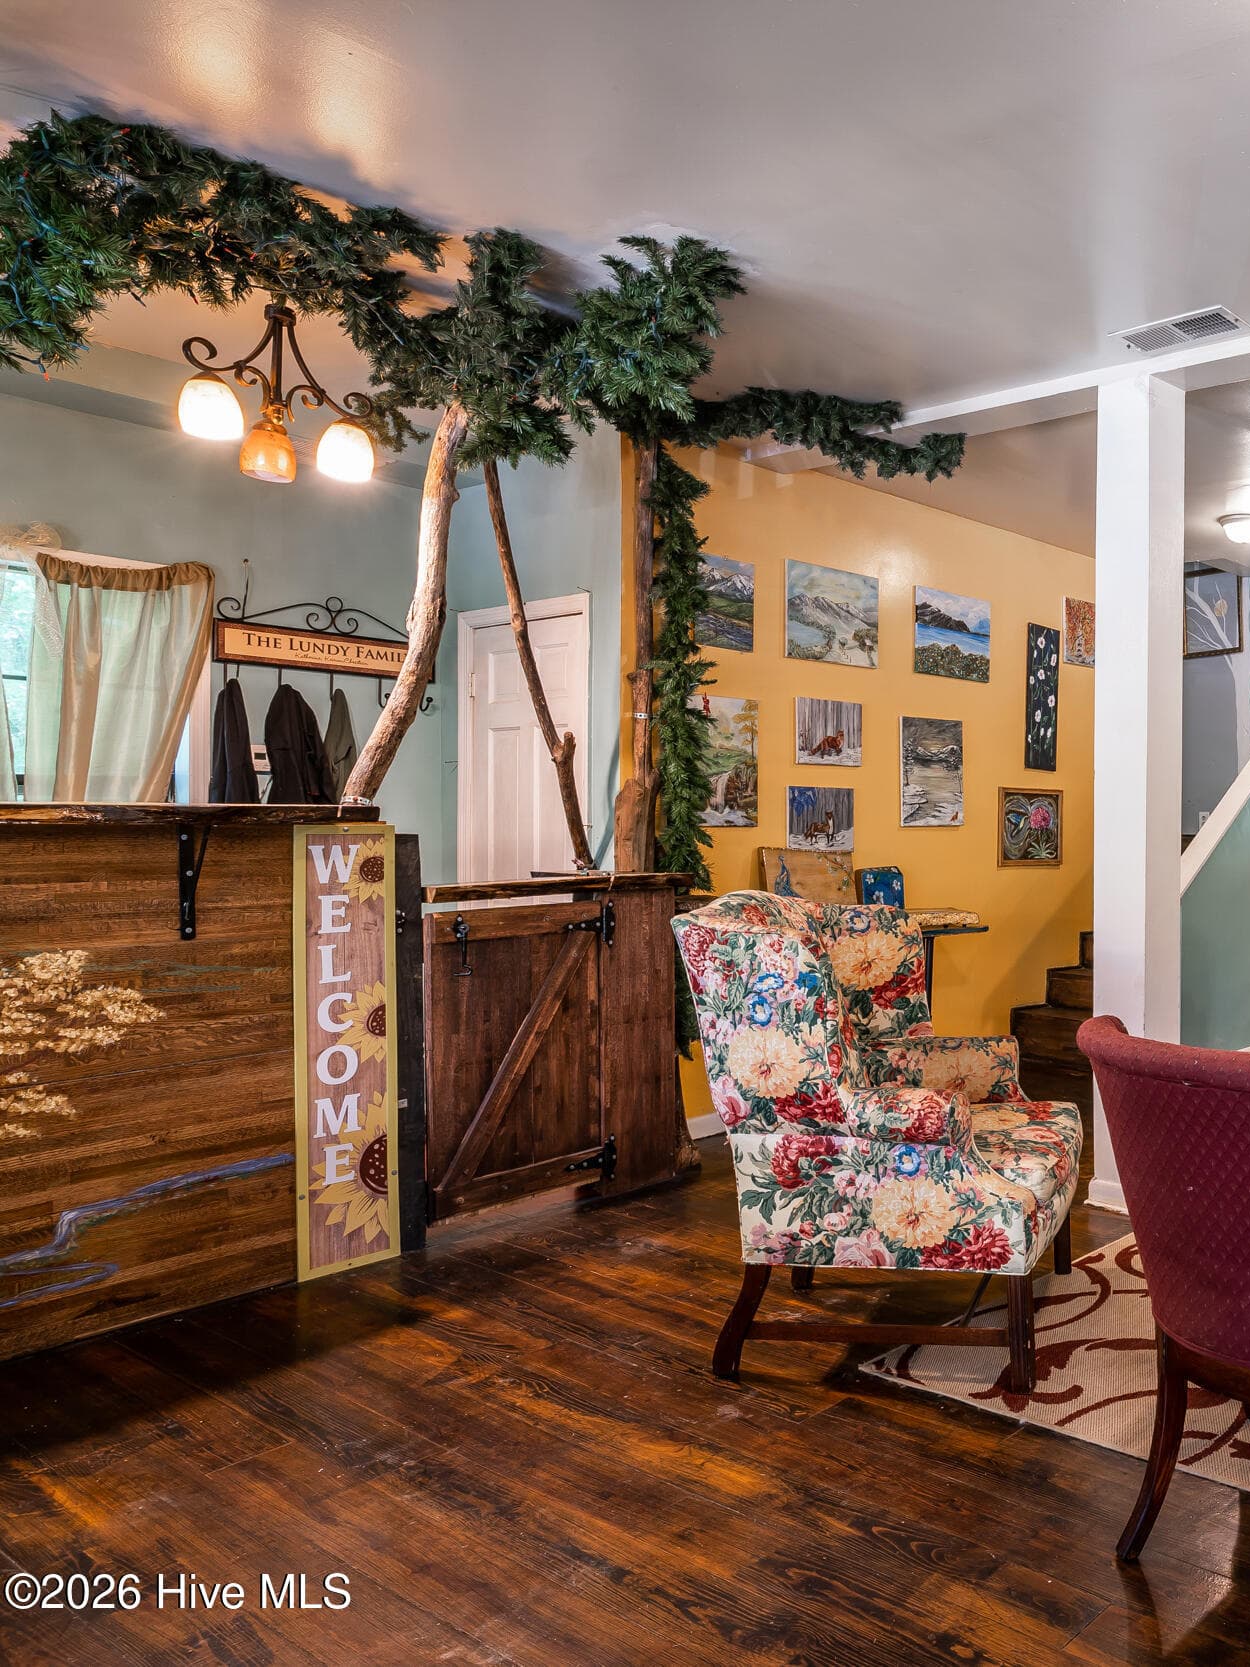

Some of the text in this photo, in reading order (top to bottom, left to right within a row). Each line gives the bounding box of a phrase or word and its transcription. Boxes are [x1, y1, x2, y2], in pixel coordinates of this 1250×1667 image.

[242, 631, 282, 649] THE
[288, 637, 350, 656] LUNDY
[355, 645, 407, 663] FAMIL
[308, 844, 361, 1186] WELCOME
